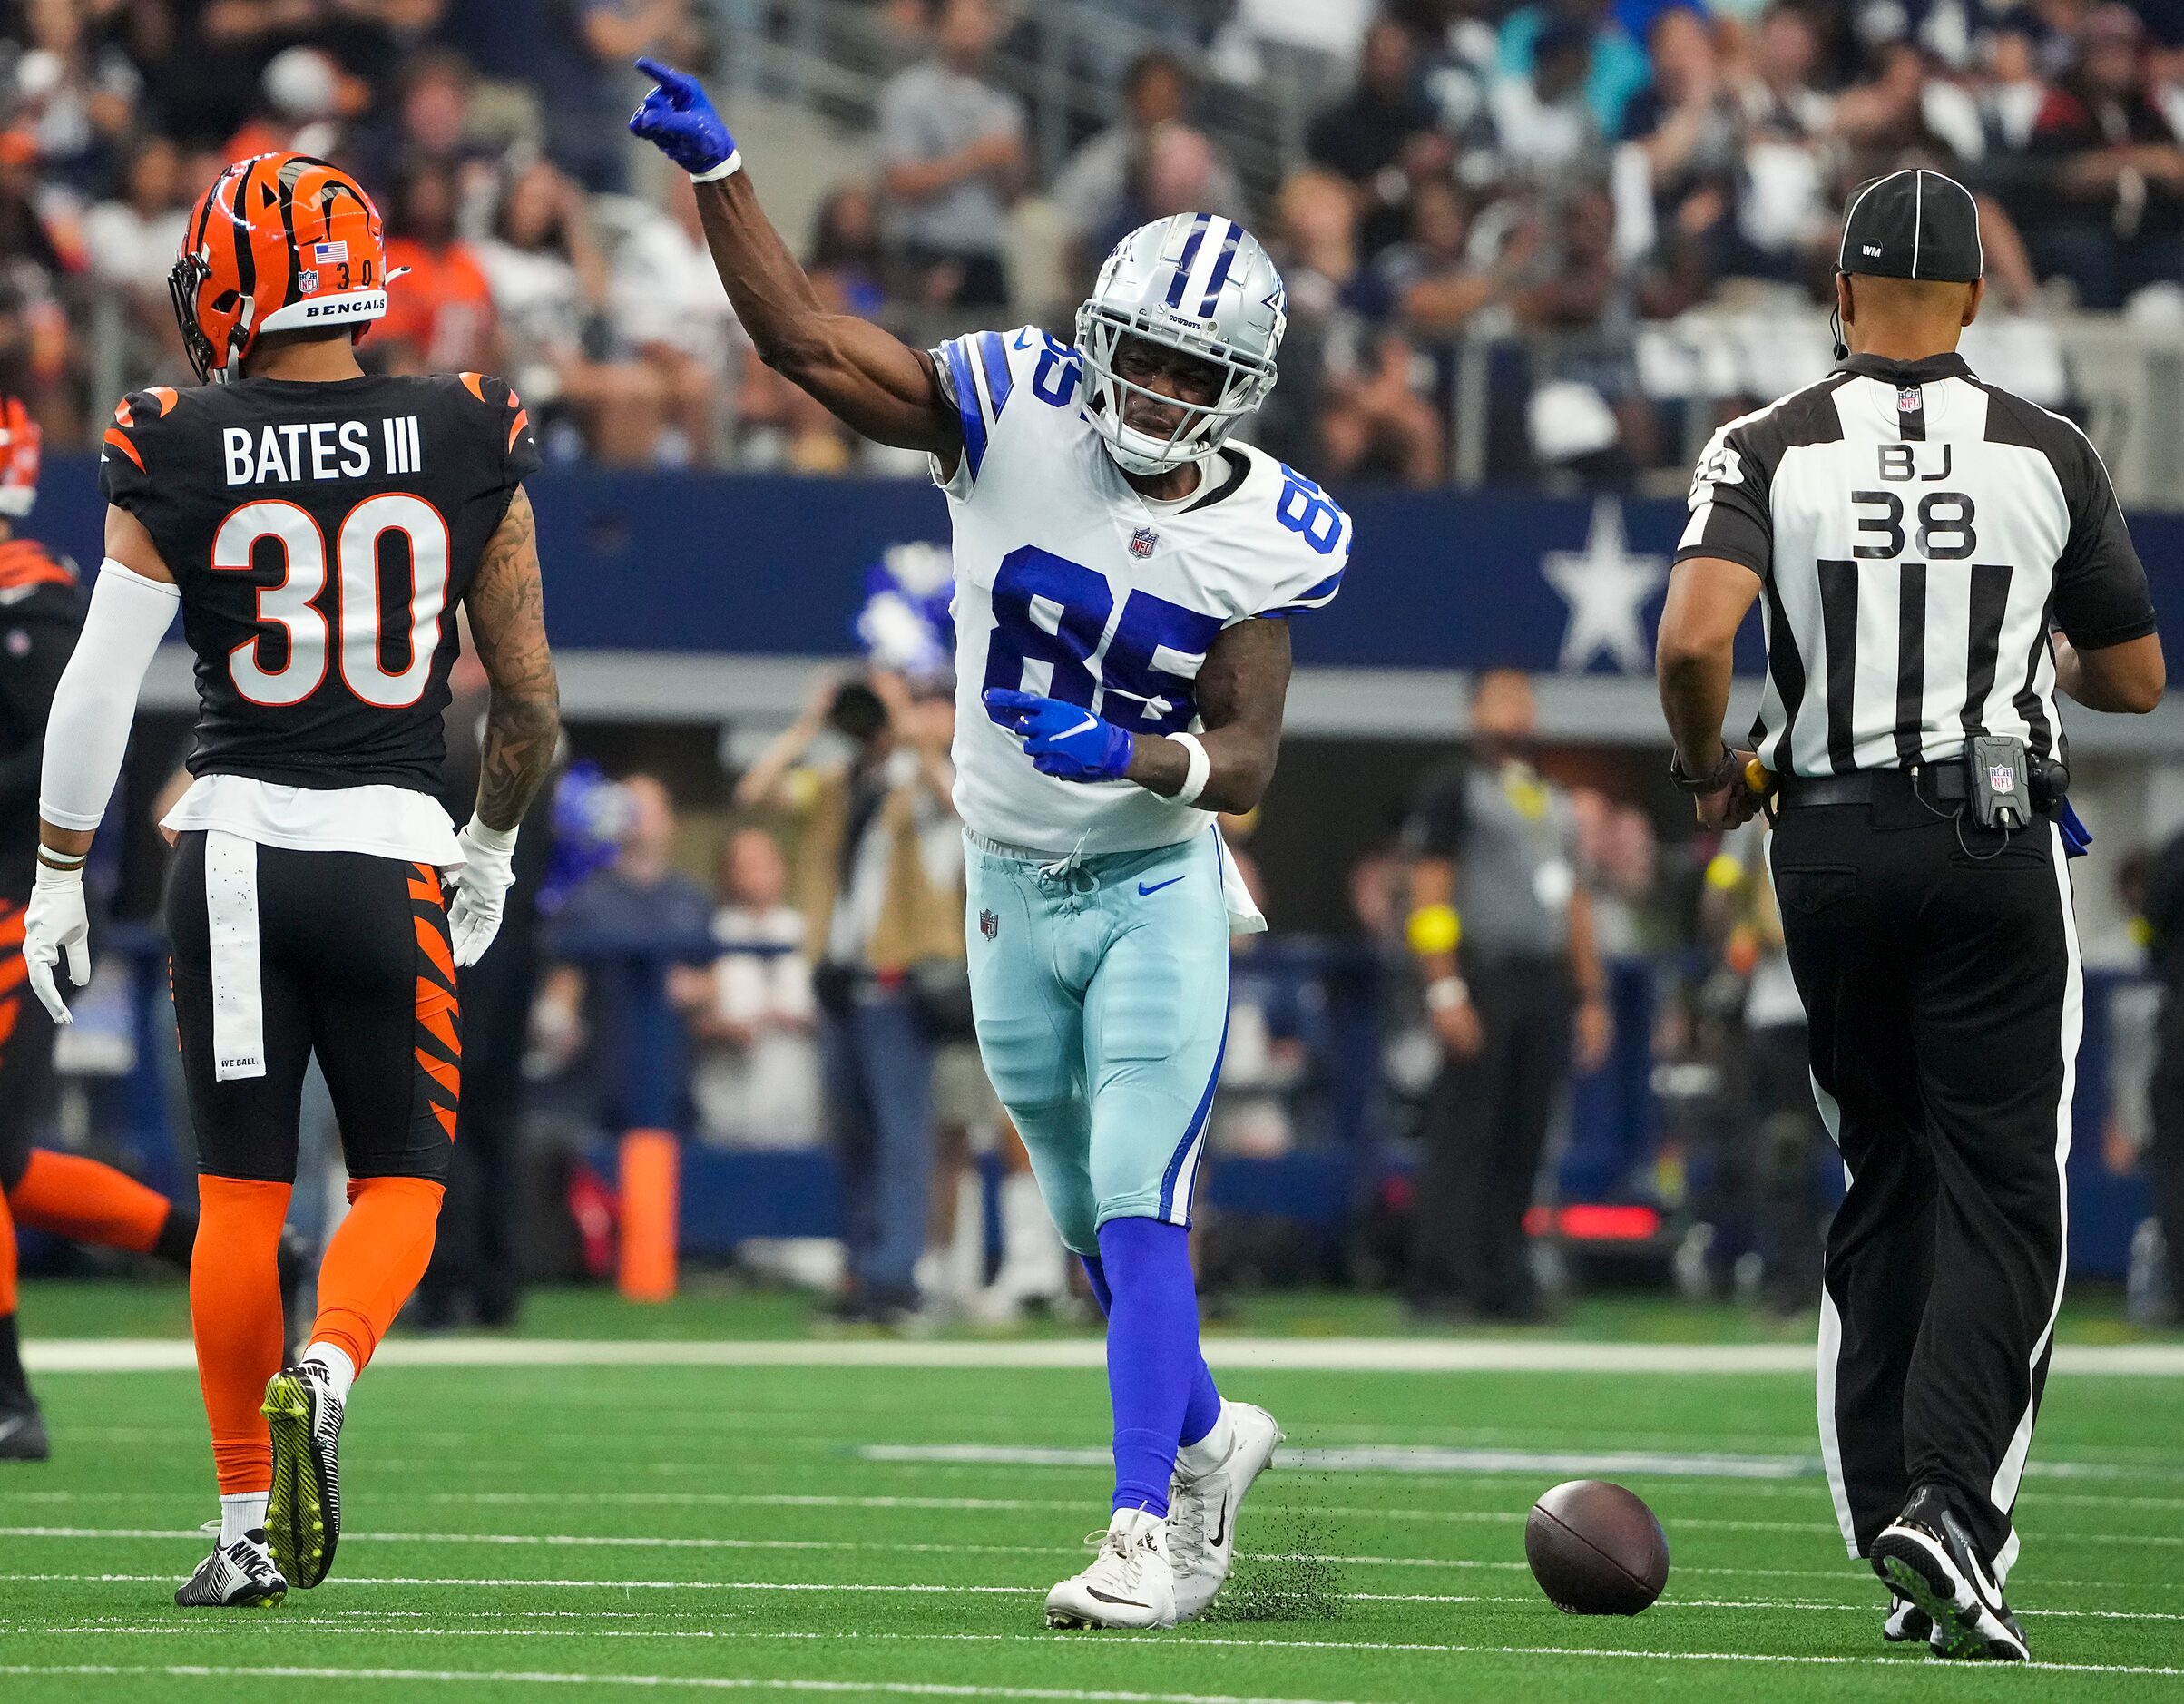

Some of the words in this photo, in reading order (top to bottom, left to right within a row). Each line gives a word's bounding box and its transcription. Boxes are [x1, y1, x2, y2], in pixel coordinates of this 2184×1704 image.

[1863, 244, 1882, 258] WM
[301, 279, 317, 289] NFL
[306, 299, 385, 318] BENGALS
[1169, 314, 1201, 330] COWBOYS
[1901, 398, 1919, 409] NFL
[223, 420, 371, 485] BATES
[382, 416, 421, 475] III
[1877, 444, 1952, 482] BJ
[1851, 490, 1977, 560] 38
[1132, 539, 1150, 554] NFL
[210, 491, 451, 709] 30
[980, 544, 1231, 738] 85
[1993, 777, 2012, 788] NFL
[221, 1059, 234, 1068] WE
[227, 1539, 275, 1582] NIKE
